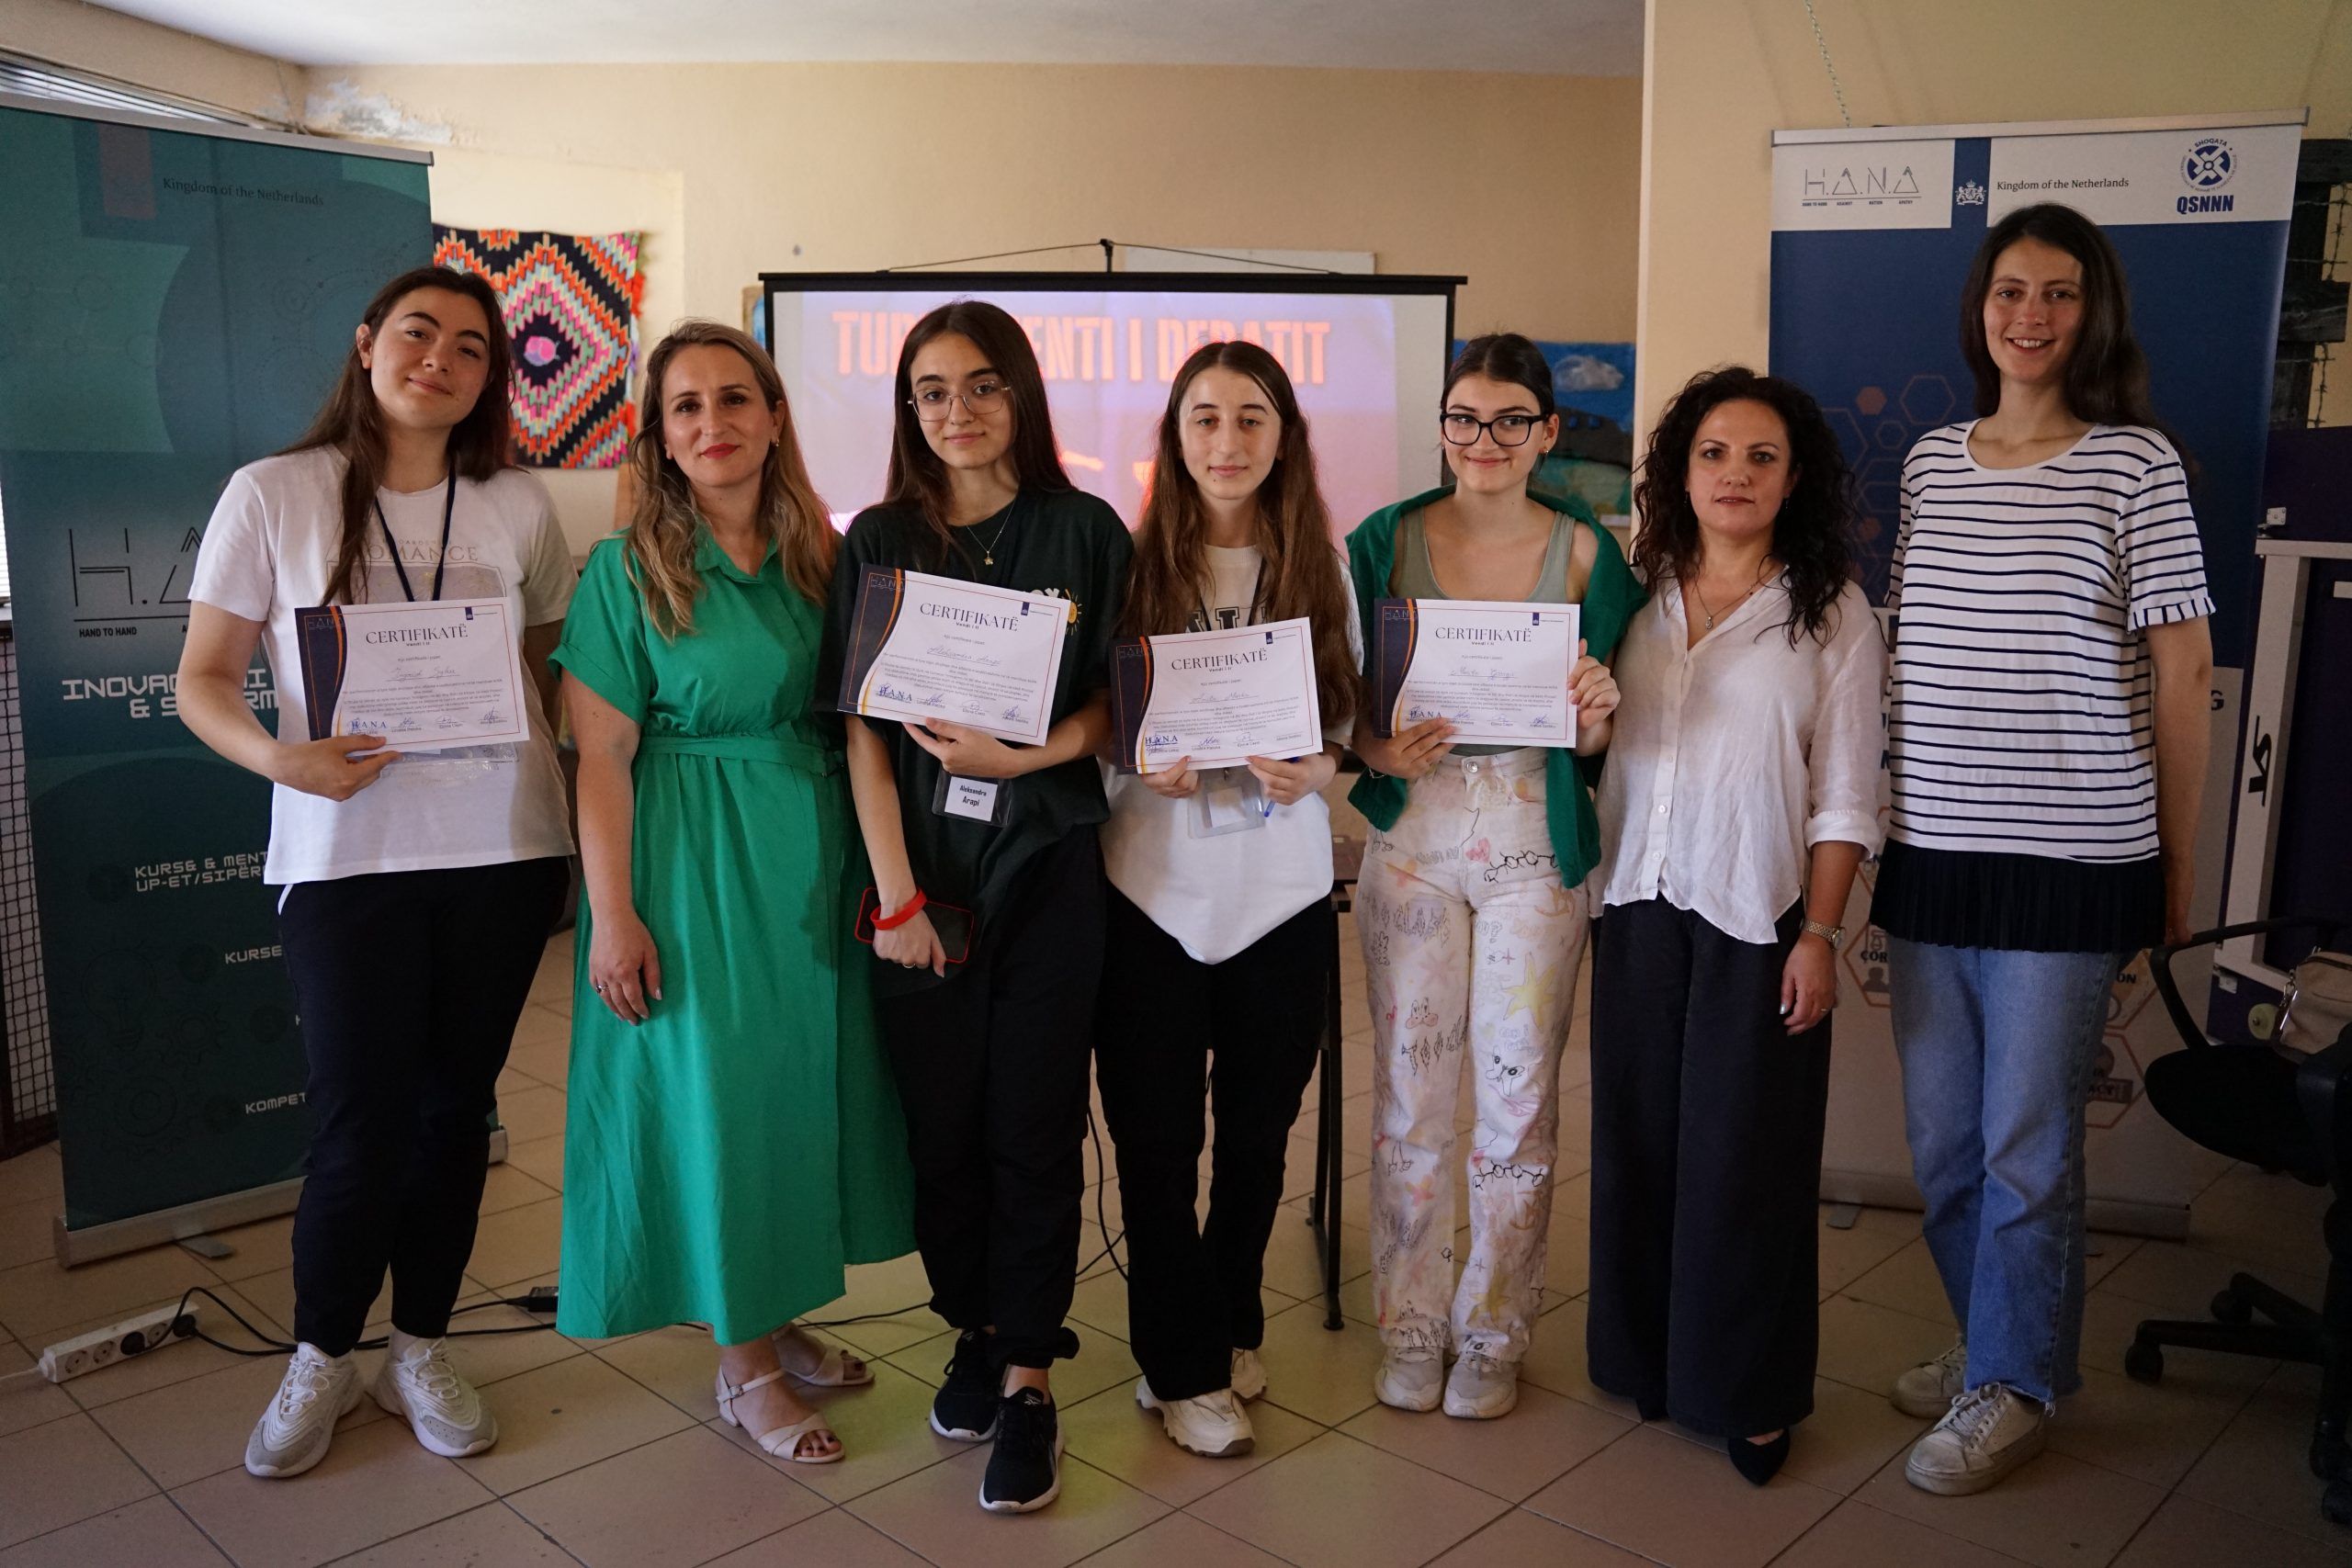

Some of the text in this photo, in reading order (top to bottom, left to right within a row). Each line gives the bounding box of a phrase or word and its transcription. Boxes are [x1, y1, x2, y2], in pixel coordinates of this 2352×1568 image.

[2194, 138, 2227, 148] SHOQATA
[164, 178, 324, 207] Kingdom of the Netherlands
[1996, 177, 2129, 193] Kingdom of the Netherlands
[2177, 195, 2233, 215] QSNNN
[920, 602, 1018, 631] CERTIFIKATË
[79, 626, 137, 637] HAND TO HAND
[366, 623, 469, 645] CERTIFIKATË
[1435, 626, 1532, 642] CERTIFIKATË
[1171, 649, 1268, 671] CERTIFIKATË
[129, 698, 150, 718] &
[960, 785, 987, 797] Aleksandra
[962, 795, 980, 807] Arapi
[205, 857, 217, 870] &
[224, 945, 283, 964] KURSE
[245, 1091, 307, 1114] KOMPET
